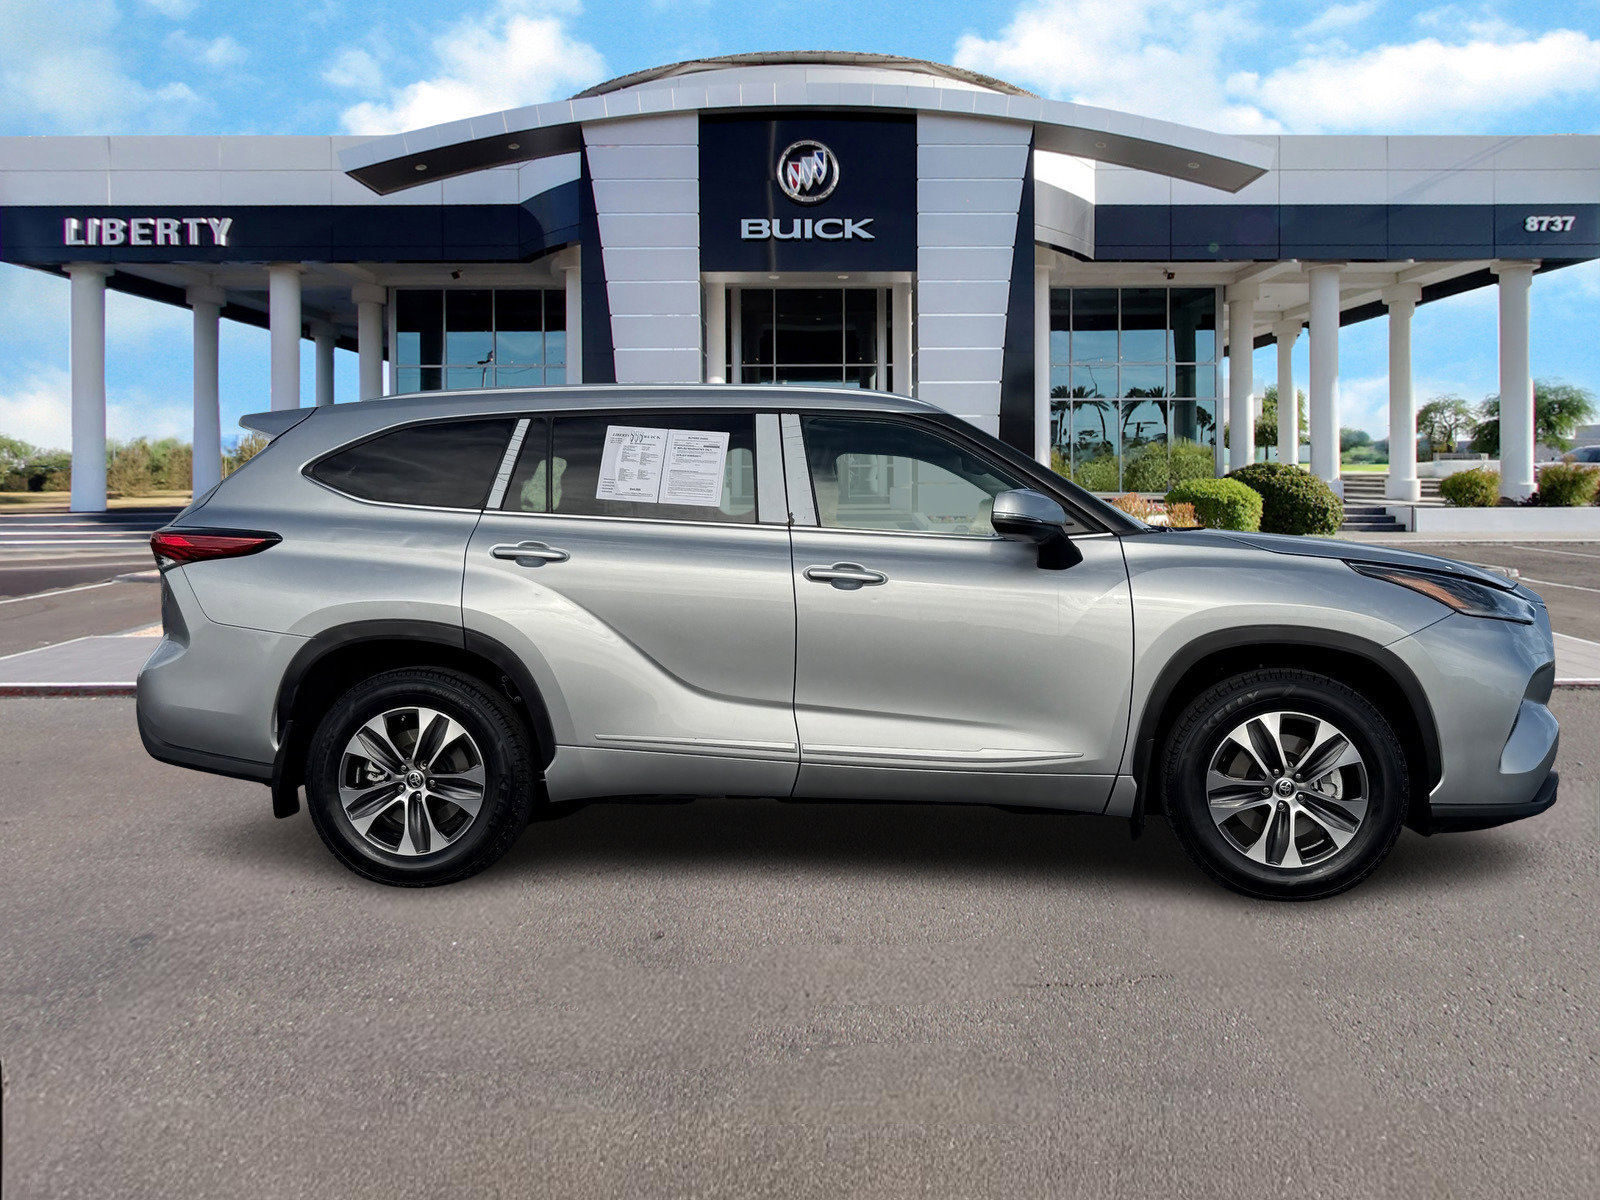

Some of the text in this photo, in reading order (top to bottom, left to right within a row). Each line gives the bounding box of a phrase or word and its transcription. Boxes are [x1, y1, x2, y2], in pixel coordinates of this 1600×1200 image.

[63, 217, 233, 247] LIBERTY
[740, 218, 876, 239] BUICK
[1524, 215, 1576, 232] 8737
[1202, 689, 1263, 731] KELLY
